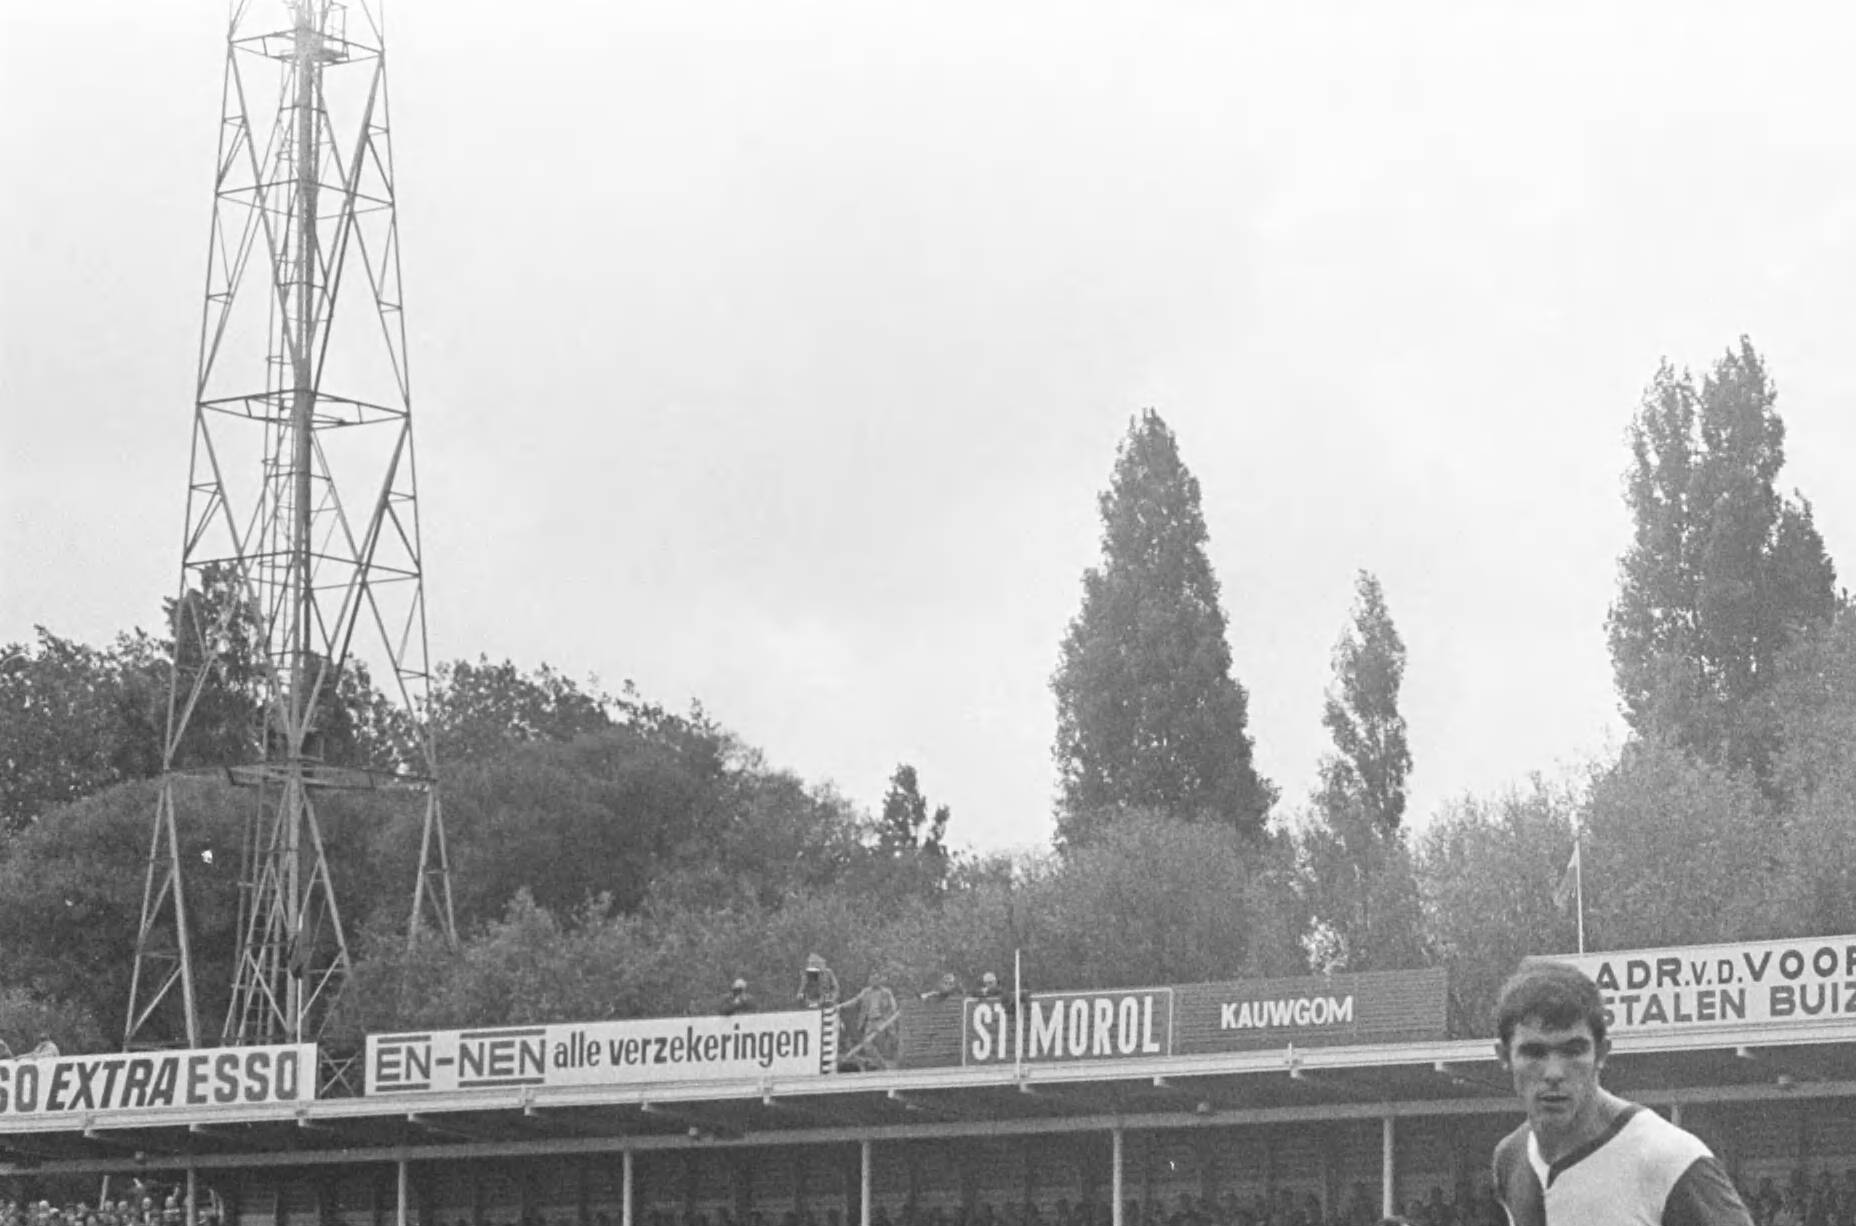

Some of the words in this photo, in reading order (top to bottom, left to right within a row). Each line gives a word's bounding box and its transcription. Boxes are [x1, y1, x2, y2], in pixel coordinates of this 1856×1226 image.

[972, 995, 1160, 1061] STIMOROL
[1221, 996, 1354, 1030] KAUWGOM
[1600, 987, 1746, 1028] STALEN
[553, 1031, 600, 1069] alle
[609, 1022, 809, 1067] verzekeringen
[46, 1057, 180, 1111] EXTRA
[186, 1051, 298, 1104] ESSO
